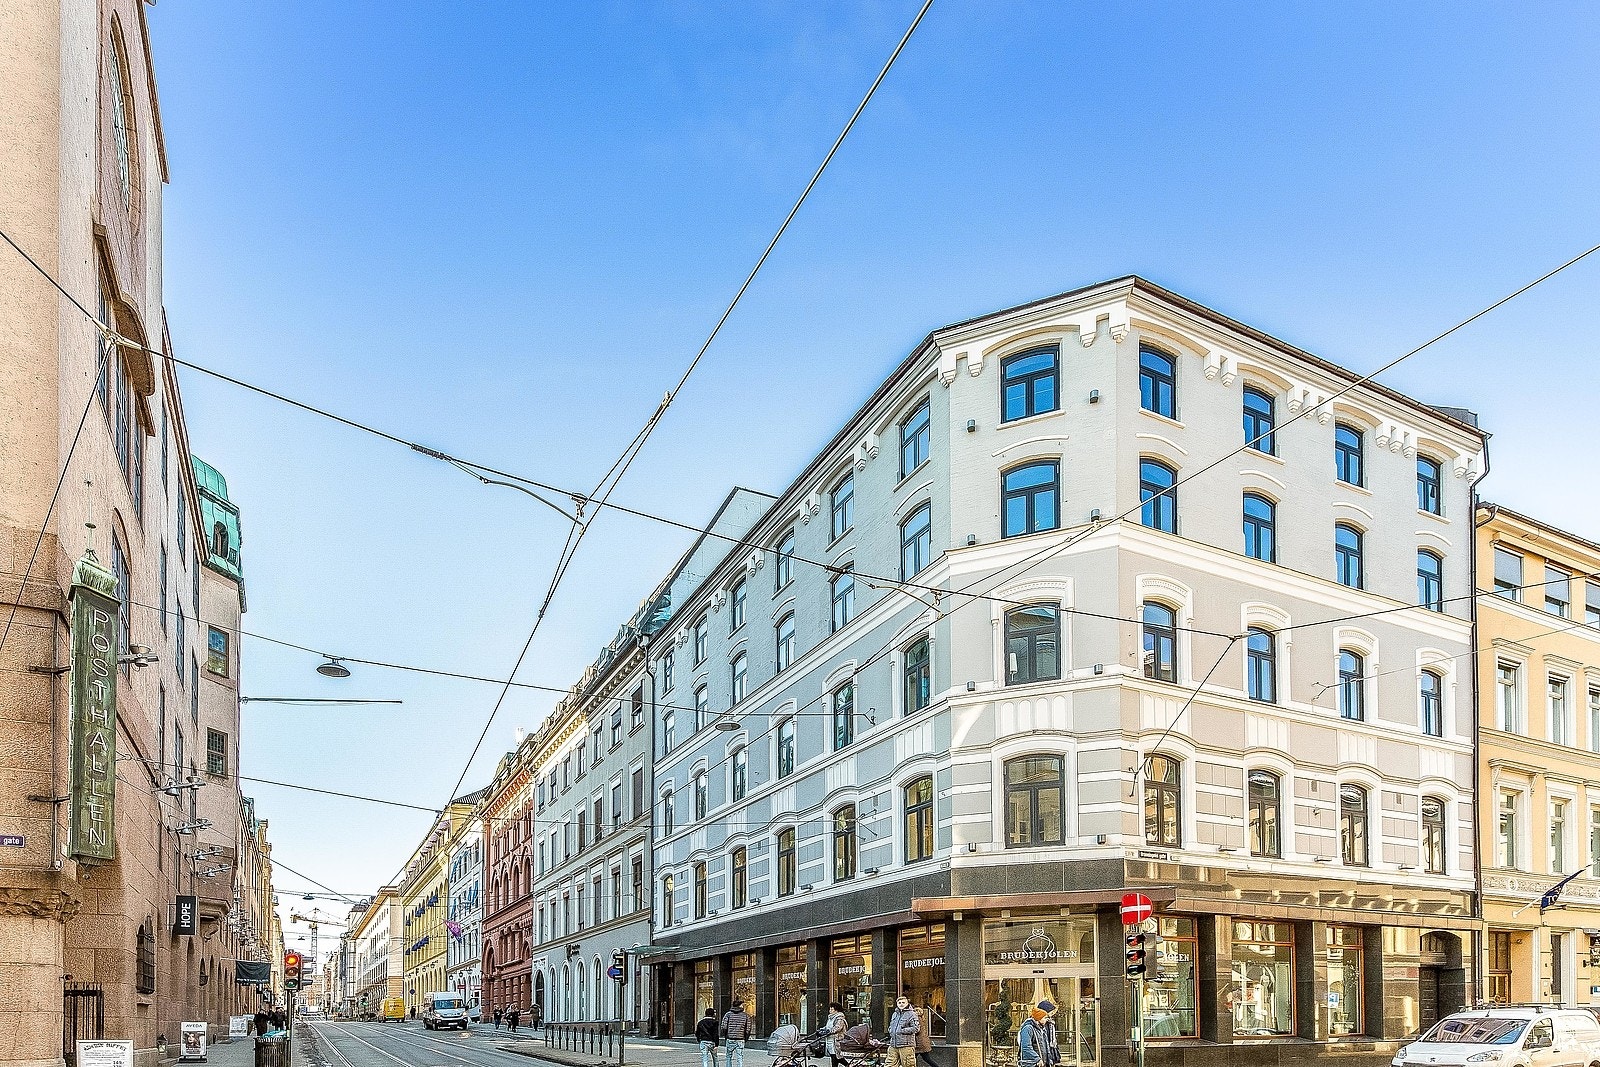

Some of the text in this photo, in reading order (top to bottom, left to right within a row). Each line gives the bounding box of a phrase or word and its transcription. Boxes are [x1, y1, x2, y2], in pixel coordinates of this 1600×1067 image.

[88, 610, 111, 846] POSTHALLEN
[3, 836, 20, 845] gate
[180, 902, 191, 928] HOPE
[1000, 950, 1078, 960] BRUDEKJOLEN
